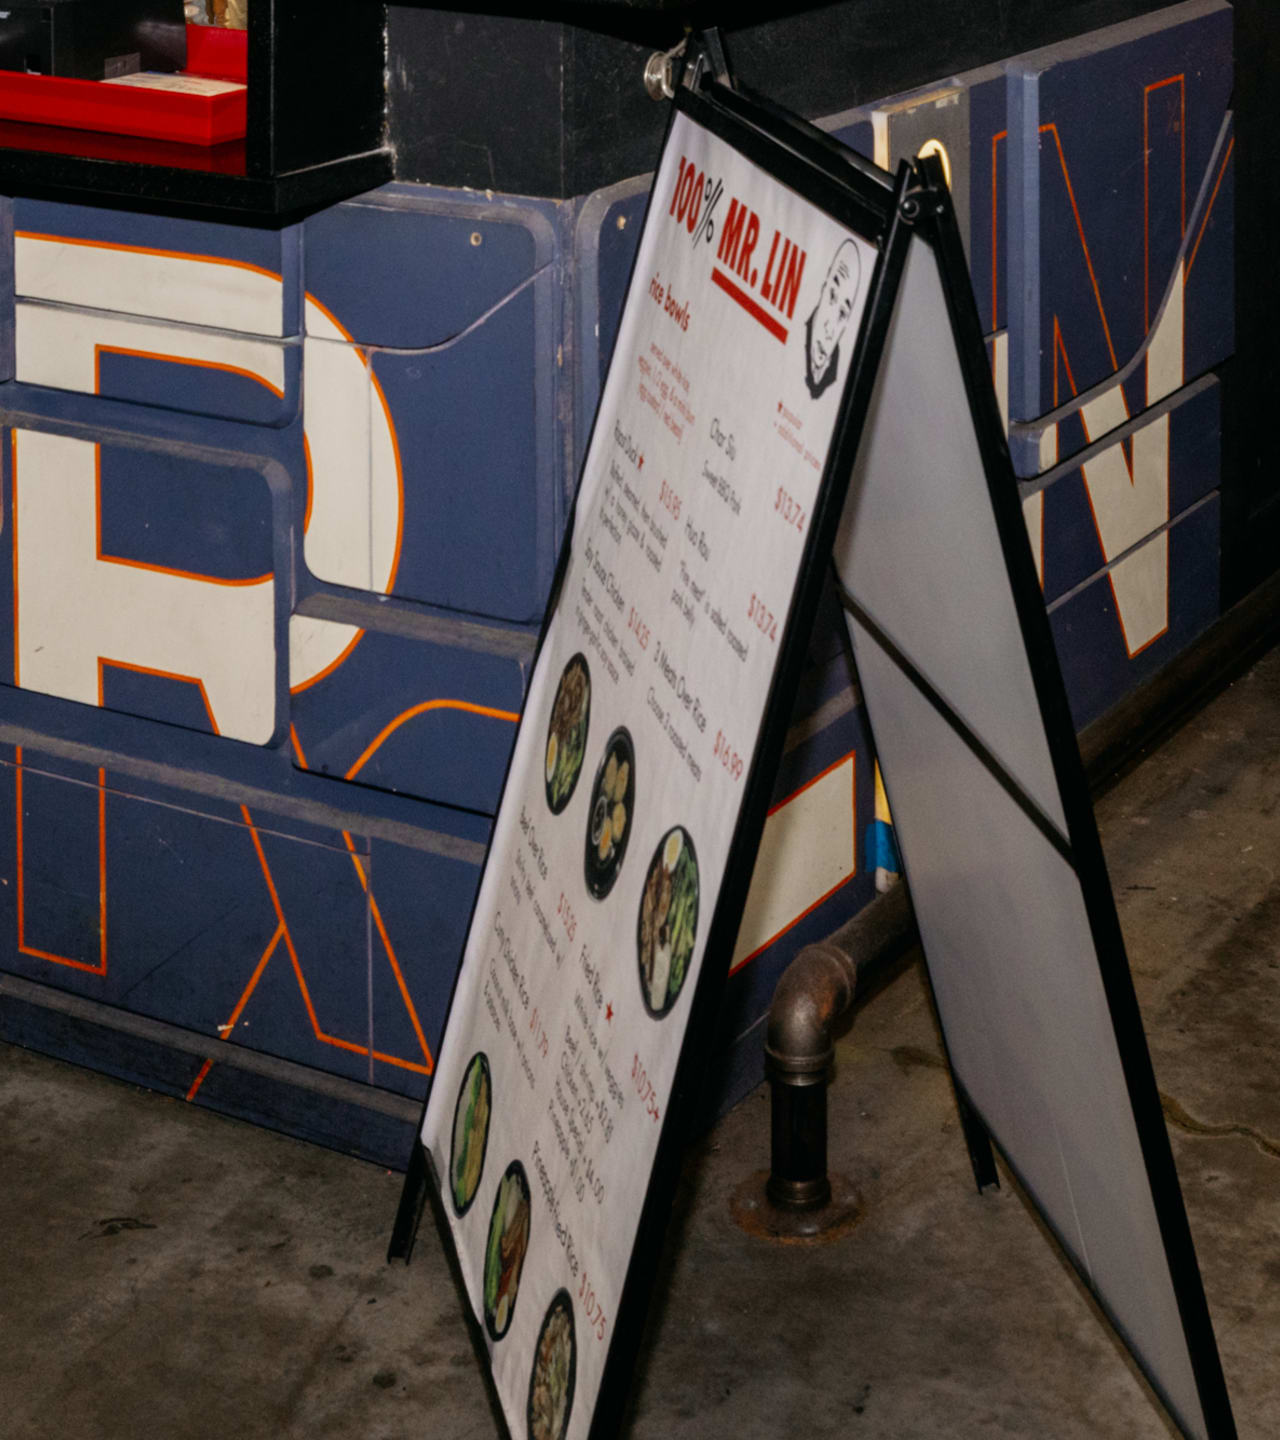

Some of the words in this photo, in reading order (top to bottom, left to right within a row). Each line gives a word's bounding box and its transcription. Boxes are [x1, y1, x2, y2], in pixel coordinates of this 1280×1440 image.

[668, 156, 723, 252] 100%
[717, 198, 762, 285] MR.
[761, 231, 807, 320] LIN
[649, 271, 665, 303] rice
[664, 286, 691, 330] bowls
[710, 417, 726, 448] Char
[724, 434, 738, 460] Siu
[658, 480, 681, 521] $15.95
[775, 488, 804, 534] $13.74
[605, 570, 625, 612] Chicken
[748, 594, 777, 644] $13.74
[659, 650, 678, 689] Meats
[676, 675, 693, 712] Over
[692, 698, 707, 733] Rice
[713, 729, 743, 788] $16.99
[517, 974, 531, 1011] Rice
[579, 943, 594, 984] Fried
[591, 971, 606, 1009] Rice
[564, 1234, 580, 1278] Rice
[579, 1269, 606, 1350] $10.75
